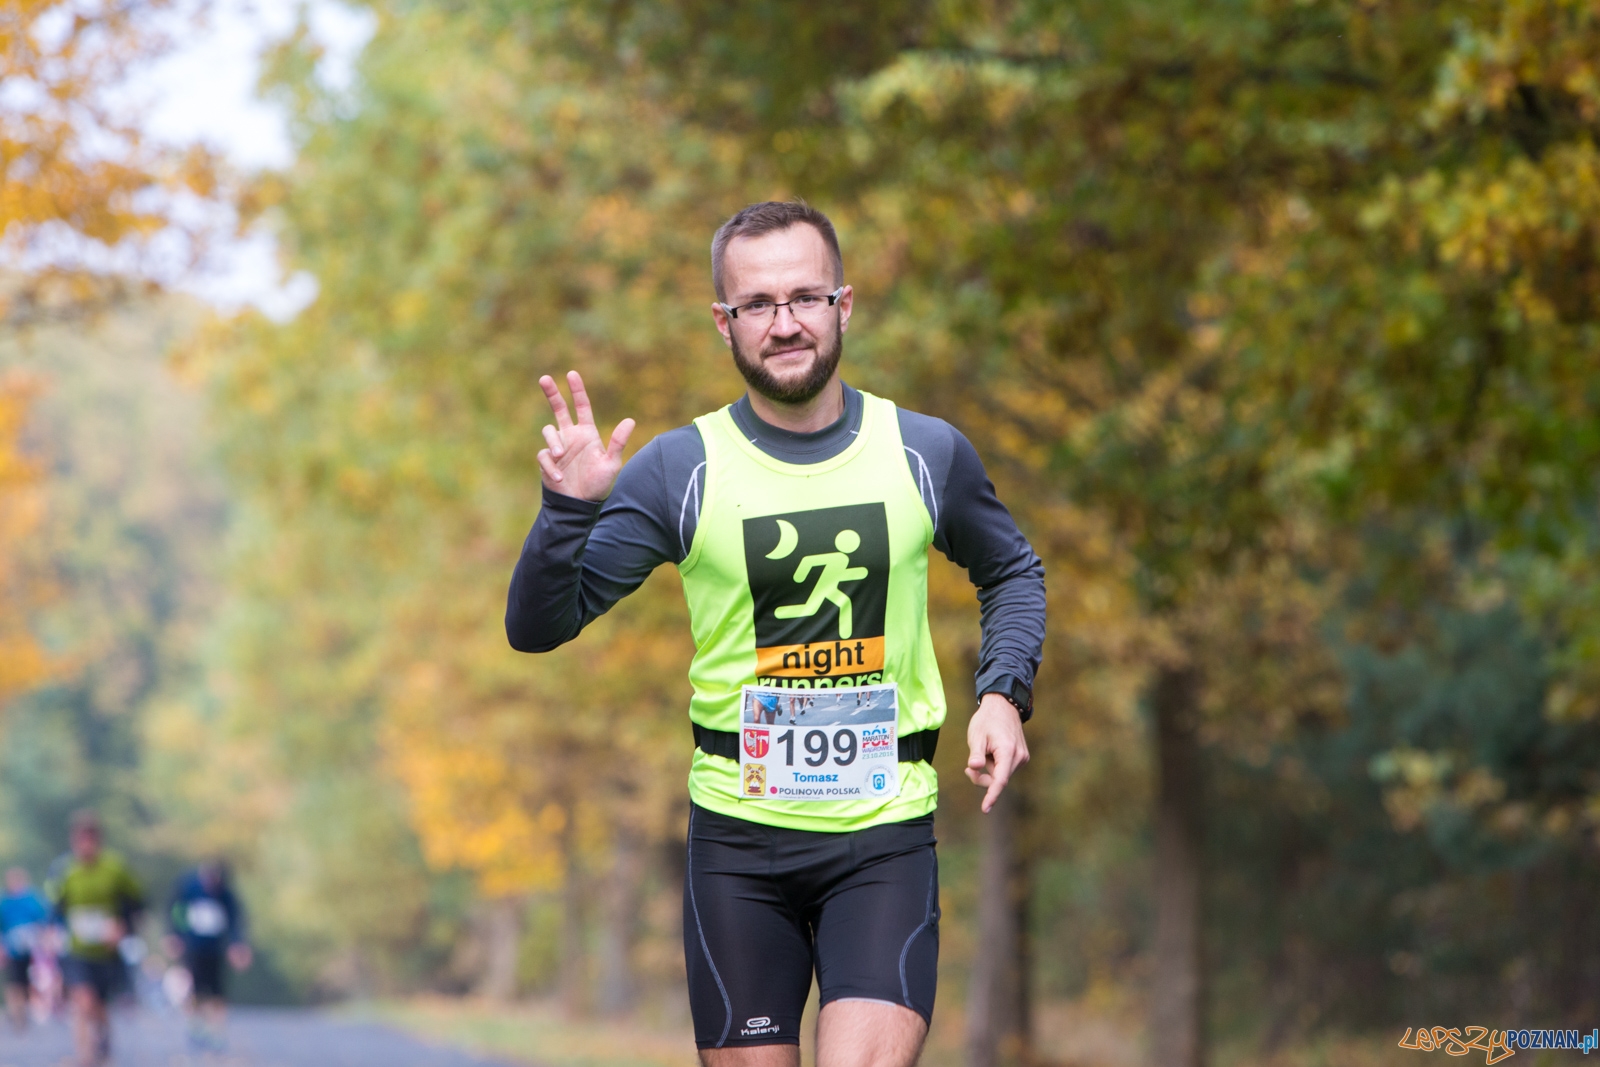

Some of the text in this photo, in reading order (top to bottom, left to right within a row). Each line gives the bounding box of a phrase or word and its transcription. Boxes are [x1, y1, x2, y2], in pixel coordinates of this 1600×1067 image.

[782, 641, 865, 675] night
[862, 734, 889, 742] MARATON
[777, 728, 858, 767] 199
[862, 751, 894, 759] 23.10.2016
[792, 772, 838, 783] Tomasz
[779, 787, 824, 796] POLINOVA
[826, 787, 861, 795] POLSKA
[740, 1025, 780, 1036] Kalenji
